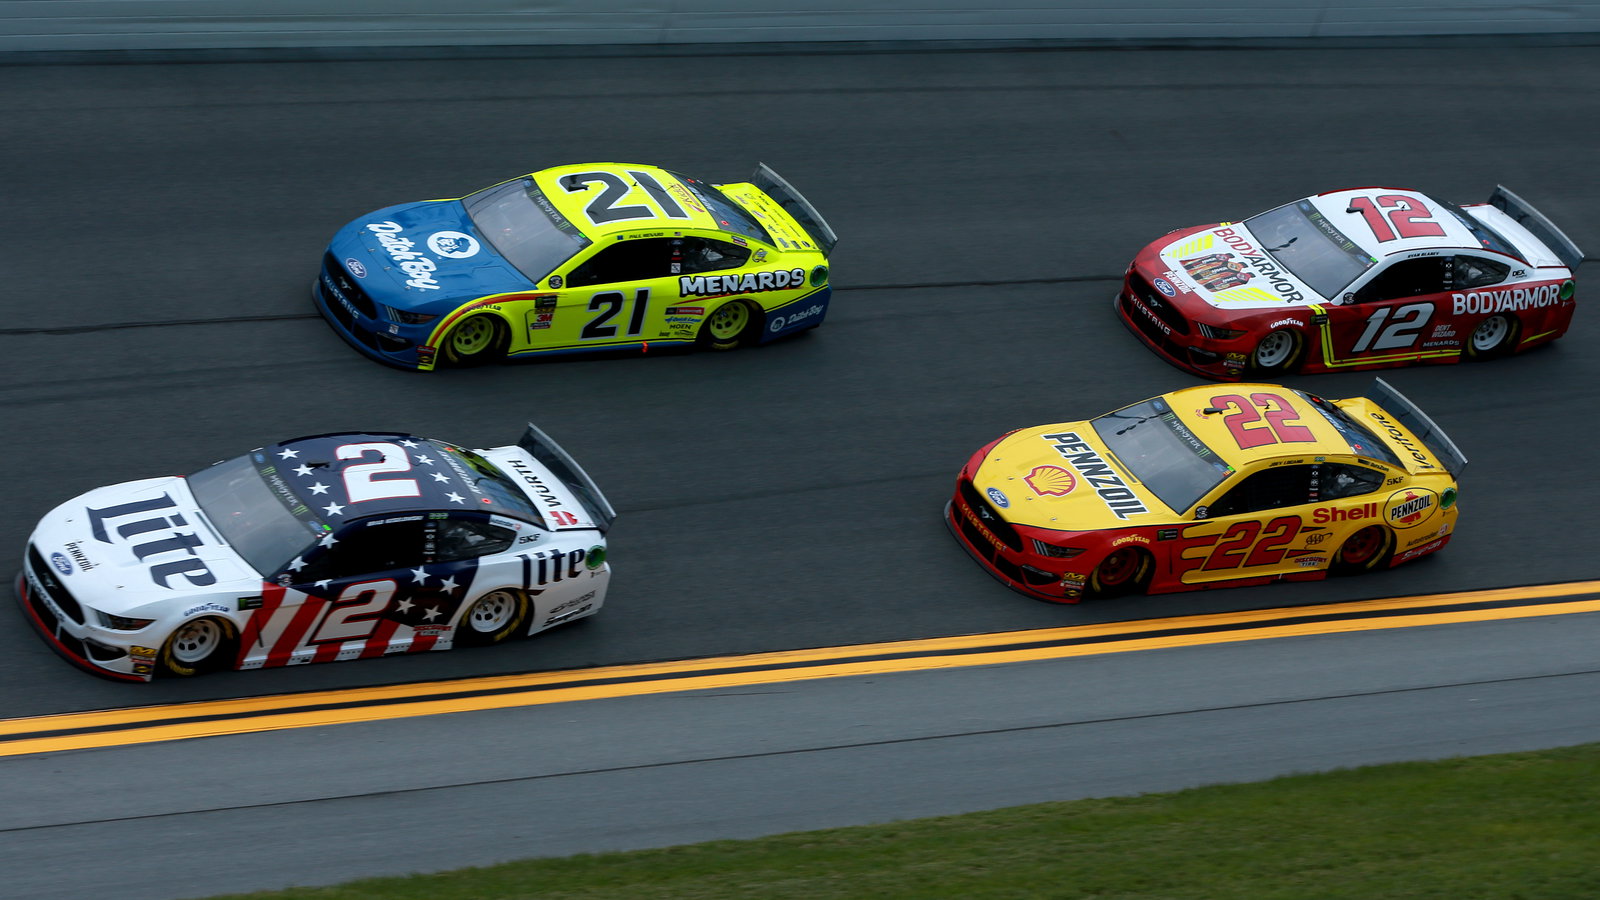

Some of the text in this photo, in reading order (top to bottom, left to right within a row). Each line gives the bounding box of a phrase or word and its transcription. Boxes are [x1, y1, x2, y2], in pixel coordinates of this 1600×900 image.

[557, 170, 692, 226] 21
[1349, 195, 1447, 244] 12
[366, 221, 440, 290] Dutch Boy
[1212, 227, 1304, 303] BODYARMOR
[679, 268, 805, 297] MENARDS
[1452, 284, 1560, 316] BODYARMOR
[537, 313, 553, 322] 3M
[579, 287, 651, 341] 21
[1130, 293, 1171, 336] MUSTANG
[1270, 317, 1304, 328] GOODYEAR
[1351, 302, 1436, 353] 12
[1210, 392, 1317, 450] 22
[1370, 412, 1434, 469] Verifone
[334, 442, 421, 504] 2
[987, 488, 1009, 508] Ford
[1041, 431, 1151, 521] PENNZOIL
[1386, 476, 1404, 486] SKF
[1312, 503, 1377, 524] Shell
[1391, 494, 1431, 521] PENNZOIL
[86, 490, 217, 590] Lite
[518, 533, 540, 544] SKF
[1112, 534, 1150, 547] GOODYEAR
[1201, 515, 1303, 571] 22
[311, 577, 398, 642] 2
